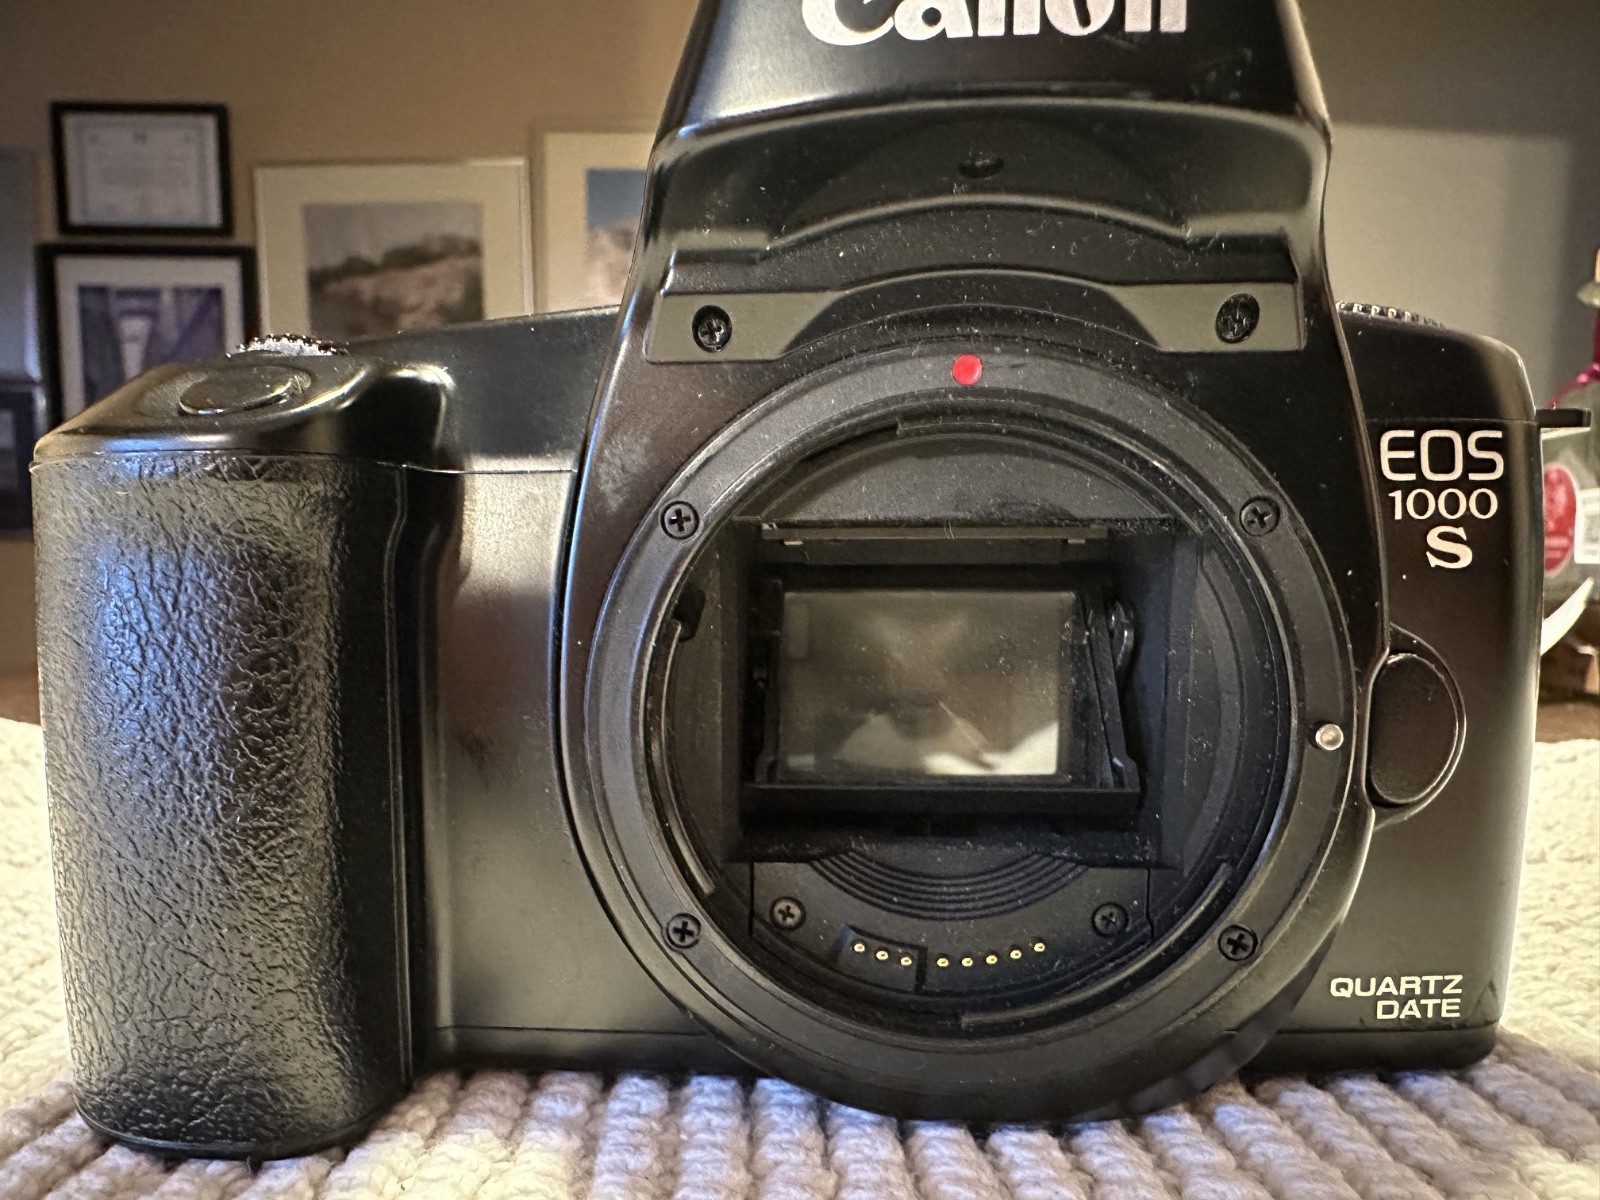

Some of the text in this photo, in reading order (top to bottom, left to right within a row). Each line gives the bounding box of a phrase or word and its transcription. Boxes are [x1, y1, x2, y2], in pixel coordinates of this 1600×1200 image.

[1380, 429, 1504, 481] EOS
[1388, 488, 1498, 520] 1000
[1425, 525, 1473, 569] S
[1330, 974, 1463, 997] QUARTZ
[1376, 998, 1462, 1020] DATE
